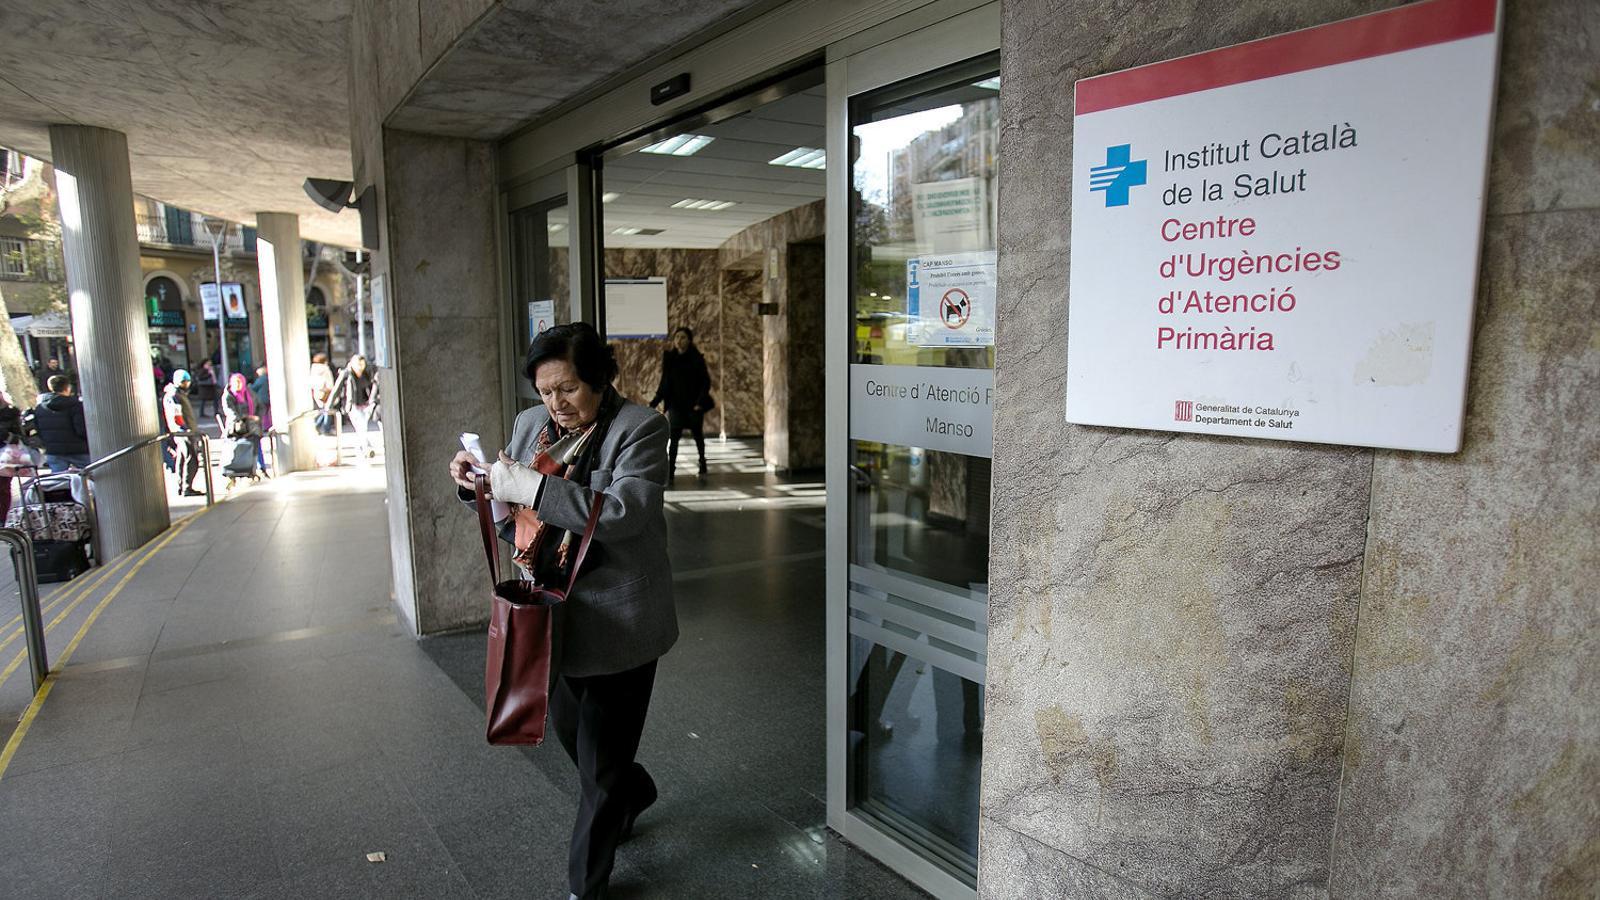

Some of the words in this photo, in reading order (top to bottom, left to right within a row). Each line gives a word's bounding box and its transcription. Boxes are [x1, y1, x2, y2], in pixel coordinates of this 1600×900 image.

[1164, 139, 1250, 172] Institut
[1259, 122, 1358, 159] Català
[1162, 183, 1192, 206] de
[1202, 179, 1223, 202] la
[1233, 168, 1307, 199] Salut
[1161, 215, 1256, 242] Centre
[1159, 246, 1341, 282] d'Urgències
[1158, 286, 1297, 314] d'Atenció
[1157, 326, 1275, 351] Primària
[866, 380, 907, 398] Centre
[1195, 403, 1240, 414] Generalitat
[1242, 406, 1253, 414] de
[1255, 406, 1300, 418] Catalunya
[1195, 414, 1252, 427] Departament
[1254, 418, 1266, 428] de
[1268, 419, 1293, 429] Salut
[926, 417, 973, 438] Manso
